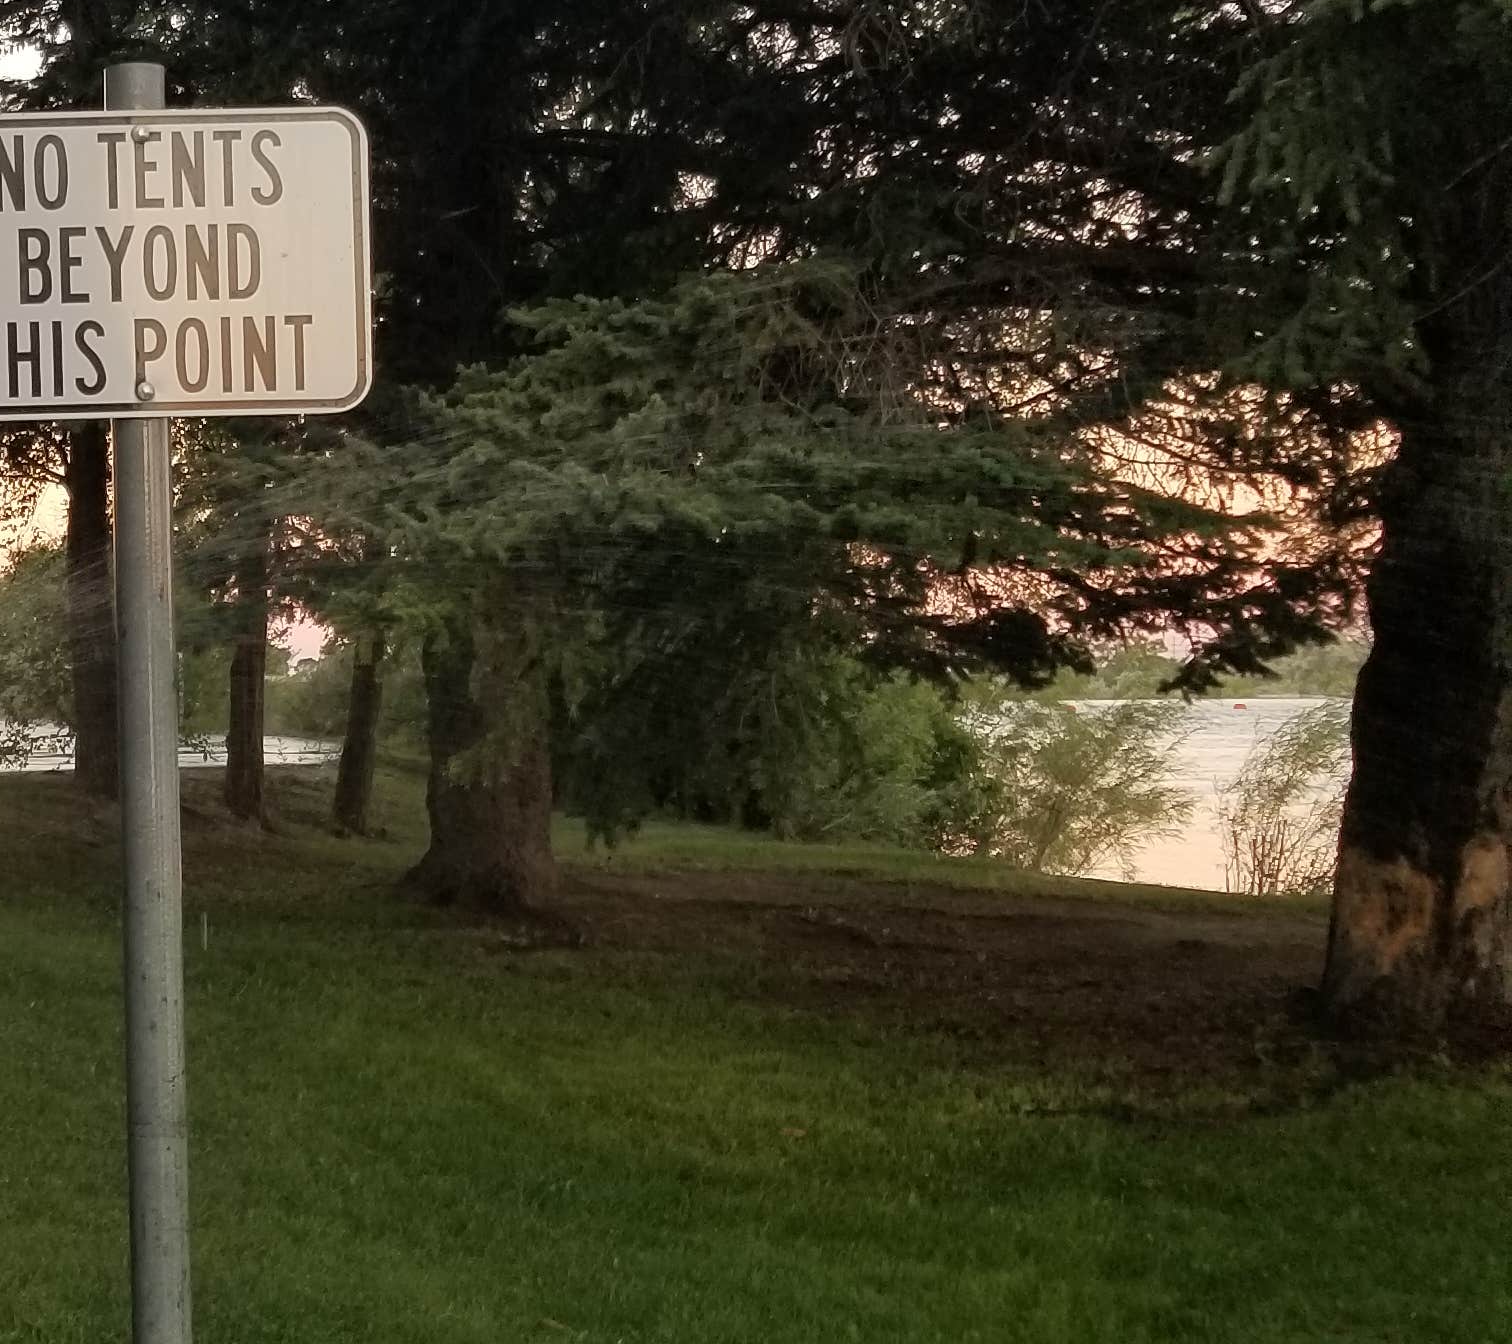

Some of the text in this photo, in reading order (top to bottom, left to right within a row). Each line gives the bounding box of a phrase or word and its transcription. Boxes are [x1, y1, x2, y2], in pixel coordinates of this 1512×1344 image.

[96, 129, 284, 210] TENTS
[17, 223, 262, 305] BEYOND
[133, 314, 314, 399] POINT
